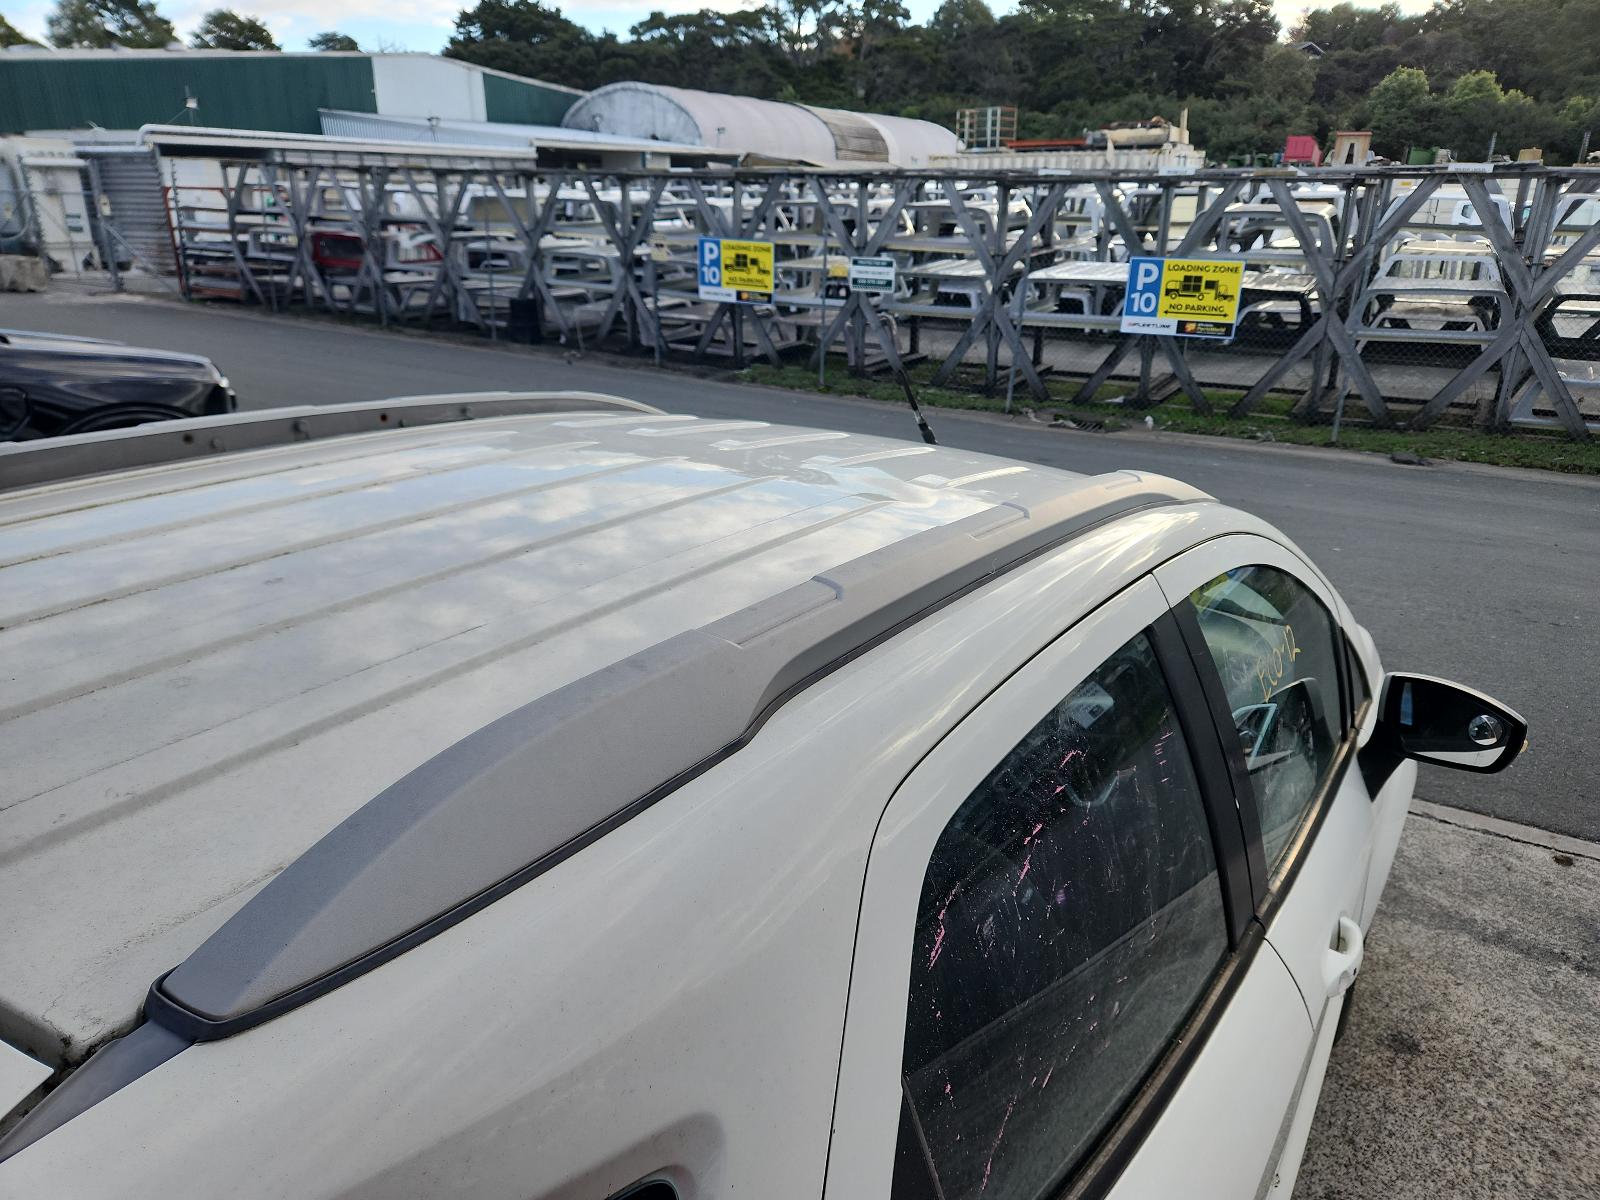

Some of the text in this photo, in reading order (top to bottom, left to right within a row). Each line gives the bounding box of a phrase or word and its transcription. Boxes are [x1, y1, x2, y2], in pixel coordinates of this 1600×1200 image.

[704, 242, 719, 266] P
[701, 266, 720, 284] 10
[1137, 263, 1159, 290] P
[1168, 264, 1241, 274] LOADING ZONE
[1130, 292, 1157, 313] 10
[1169, 303, 1225, 313] NO PARKING
